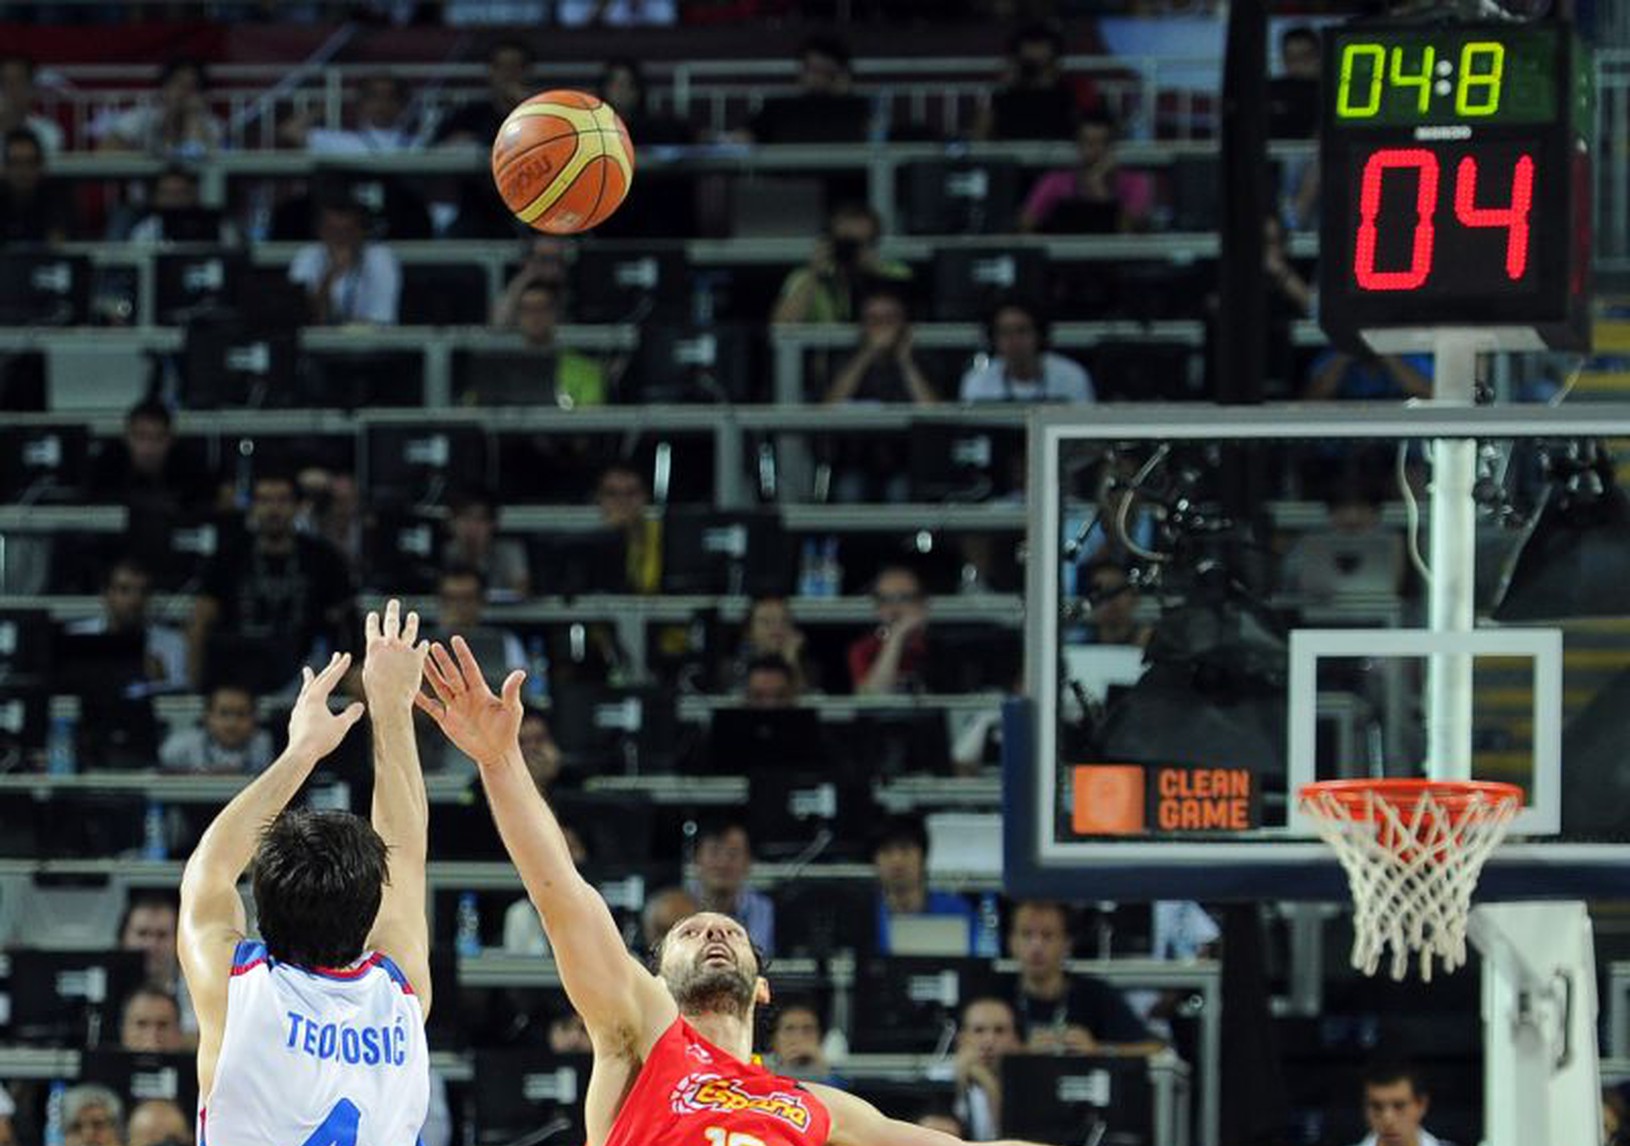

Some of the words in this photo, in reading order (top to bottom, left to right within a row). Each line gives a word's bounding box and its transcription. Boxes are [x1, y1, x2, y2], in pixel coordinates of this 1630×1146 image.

[1336, 42, 1505, 118] 04:8
[1354, 149, 1535, 291] 04
[1159, 769, 1250, 798] CLEAN
[1159, 801, 1249, 830] GAME
[286, 1010, 405, 1067] TEOOSIĆ
